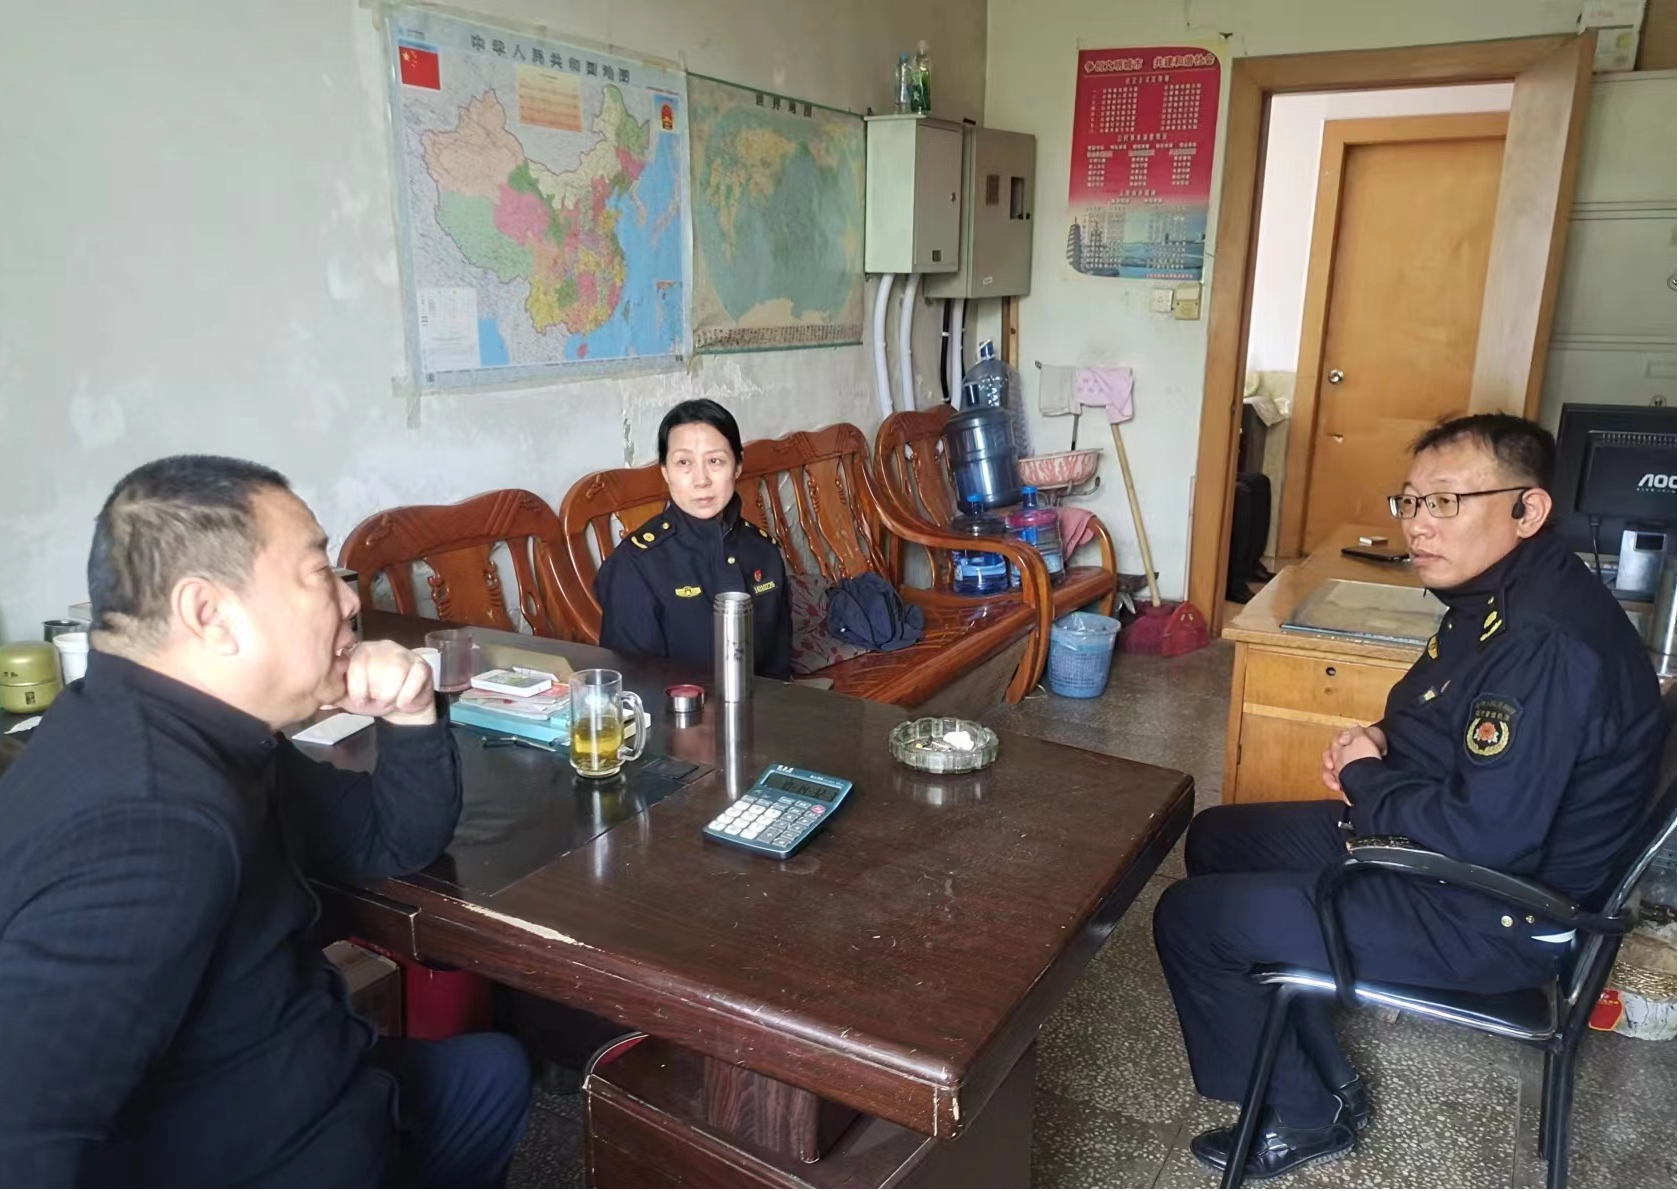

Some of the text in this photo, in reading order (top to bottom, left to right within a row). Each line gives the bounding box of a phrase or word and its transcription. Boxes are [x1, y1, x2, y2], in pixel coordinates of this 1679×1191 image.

[471, 34, 630, 84] 中华人民共和国地图
[1153, 53, 1215, 69] 共建和谐社会
